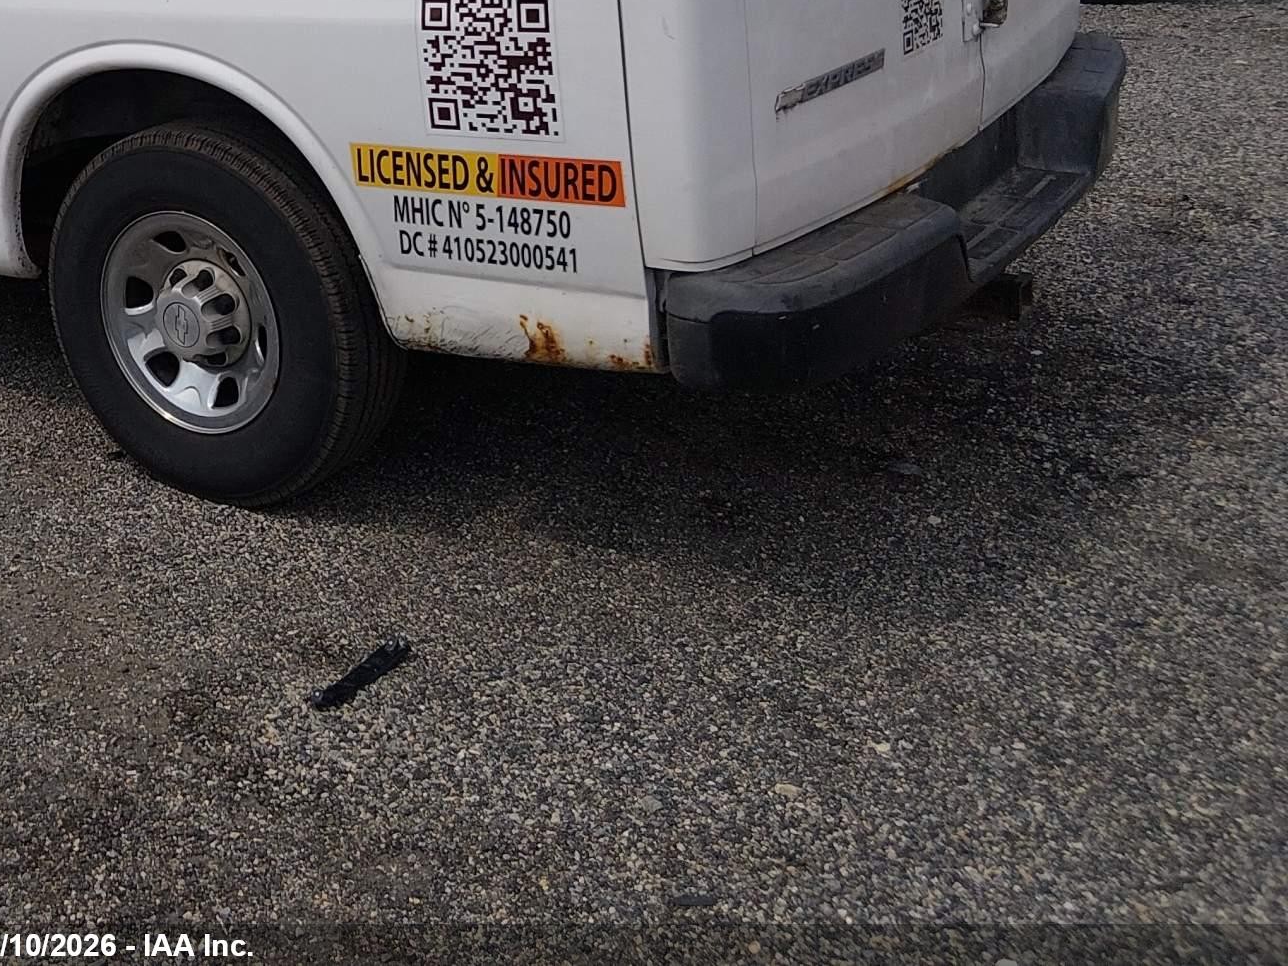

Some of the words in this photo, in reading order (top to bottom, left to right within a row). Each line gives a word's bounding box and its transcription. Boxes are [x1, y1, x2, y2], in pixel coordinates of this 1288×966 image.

[357, 147, 469, 191] LICENSED
[476, 156, 495, 193] &
[500, 157, 617, 203] INSURED
[394, 195, 444, 227] MHIC
[475, 205, 571, 239] 5-148750
[399, 230, 424, 257] DC
[428, 236, 438, 258] #
[443, 236, 578, 274] 410523000541
